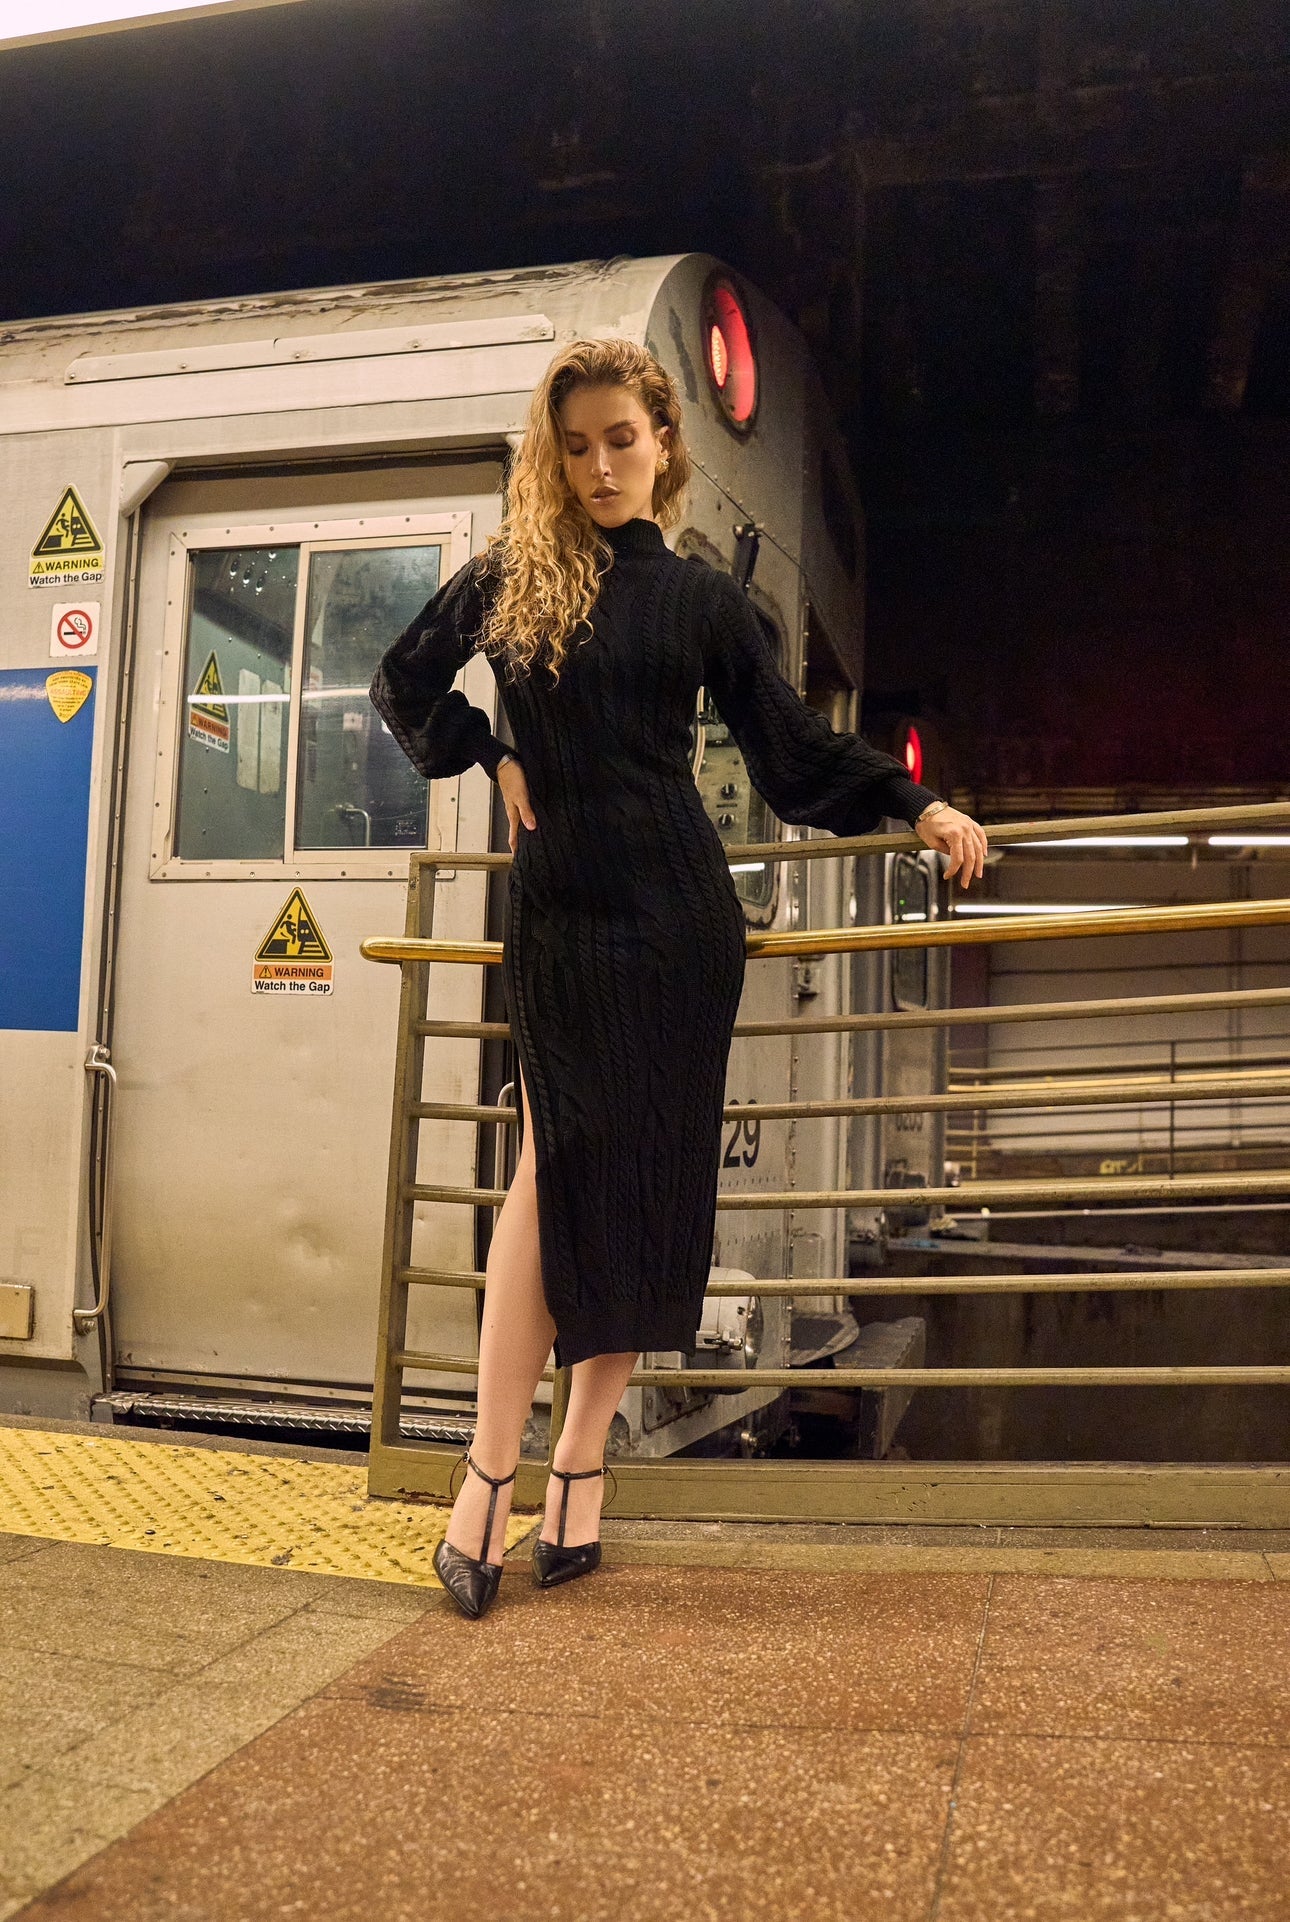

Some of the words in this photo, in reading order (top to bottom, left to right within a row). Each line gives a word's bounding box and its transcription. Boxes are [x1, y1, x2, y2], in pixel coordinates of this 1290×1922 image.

[45, 558, 99, 571] WARNING
[30, 575, 61, 585] Watch
[63, 573, 79, 583] the
[81, 572, 102, 582] Gap
[197, 717, 228, 738] WARNING
[190, 728, 206, 741] Watch
[207, 734, 216, 745] the
[217, 738, 229, 751] Gap
[274, 967, 324, 977] WARNING
[254, 980, 286, 991] Watch
[289, 981, 306, 991] the
[308, 981, 331, 994] Gap
[723, 1099, 761, 1169] 29
